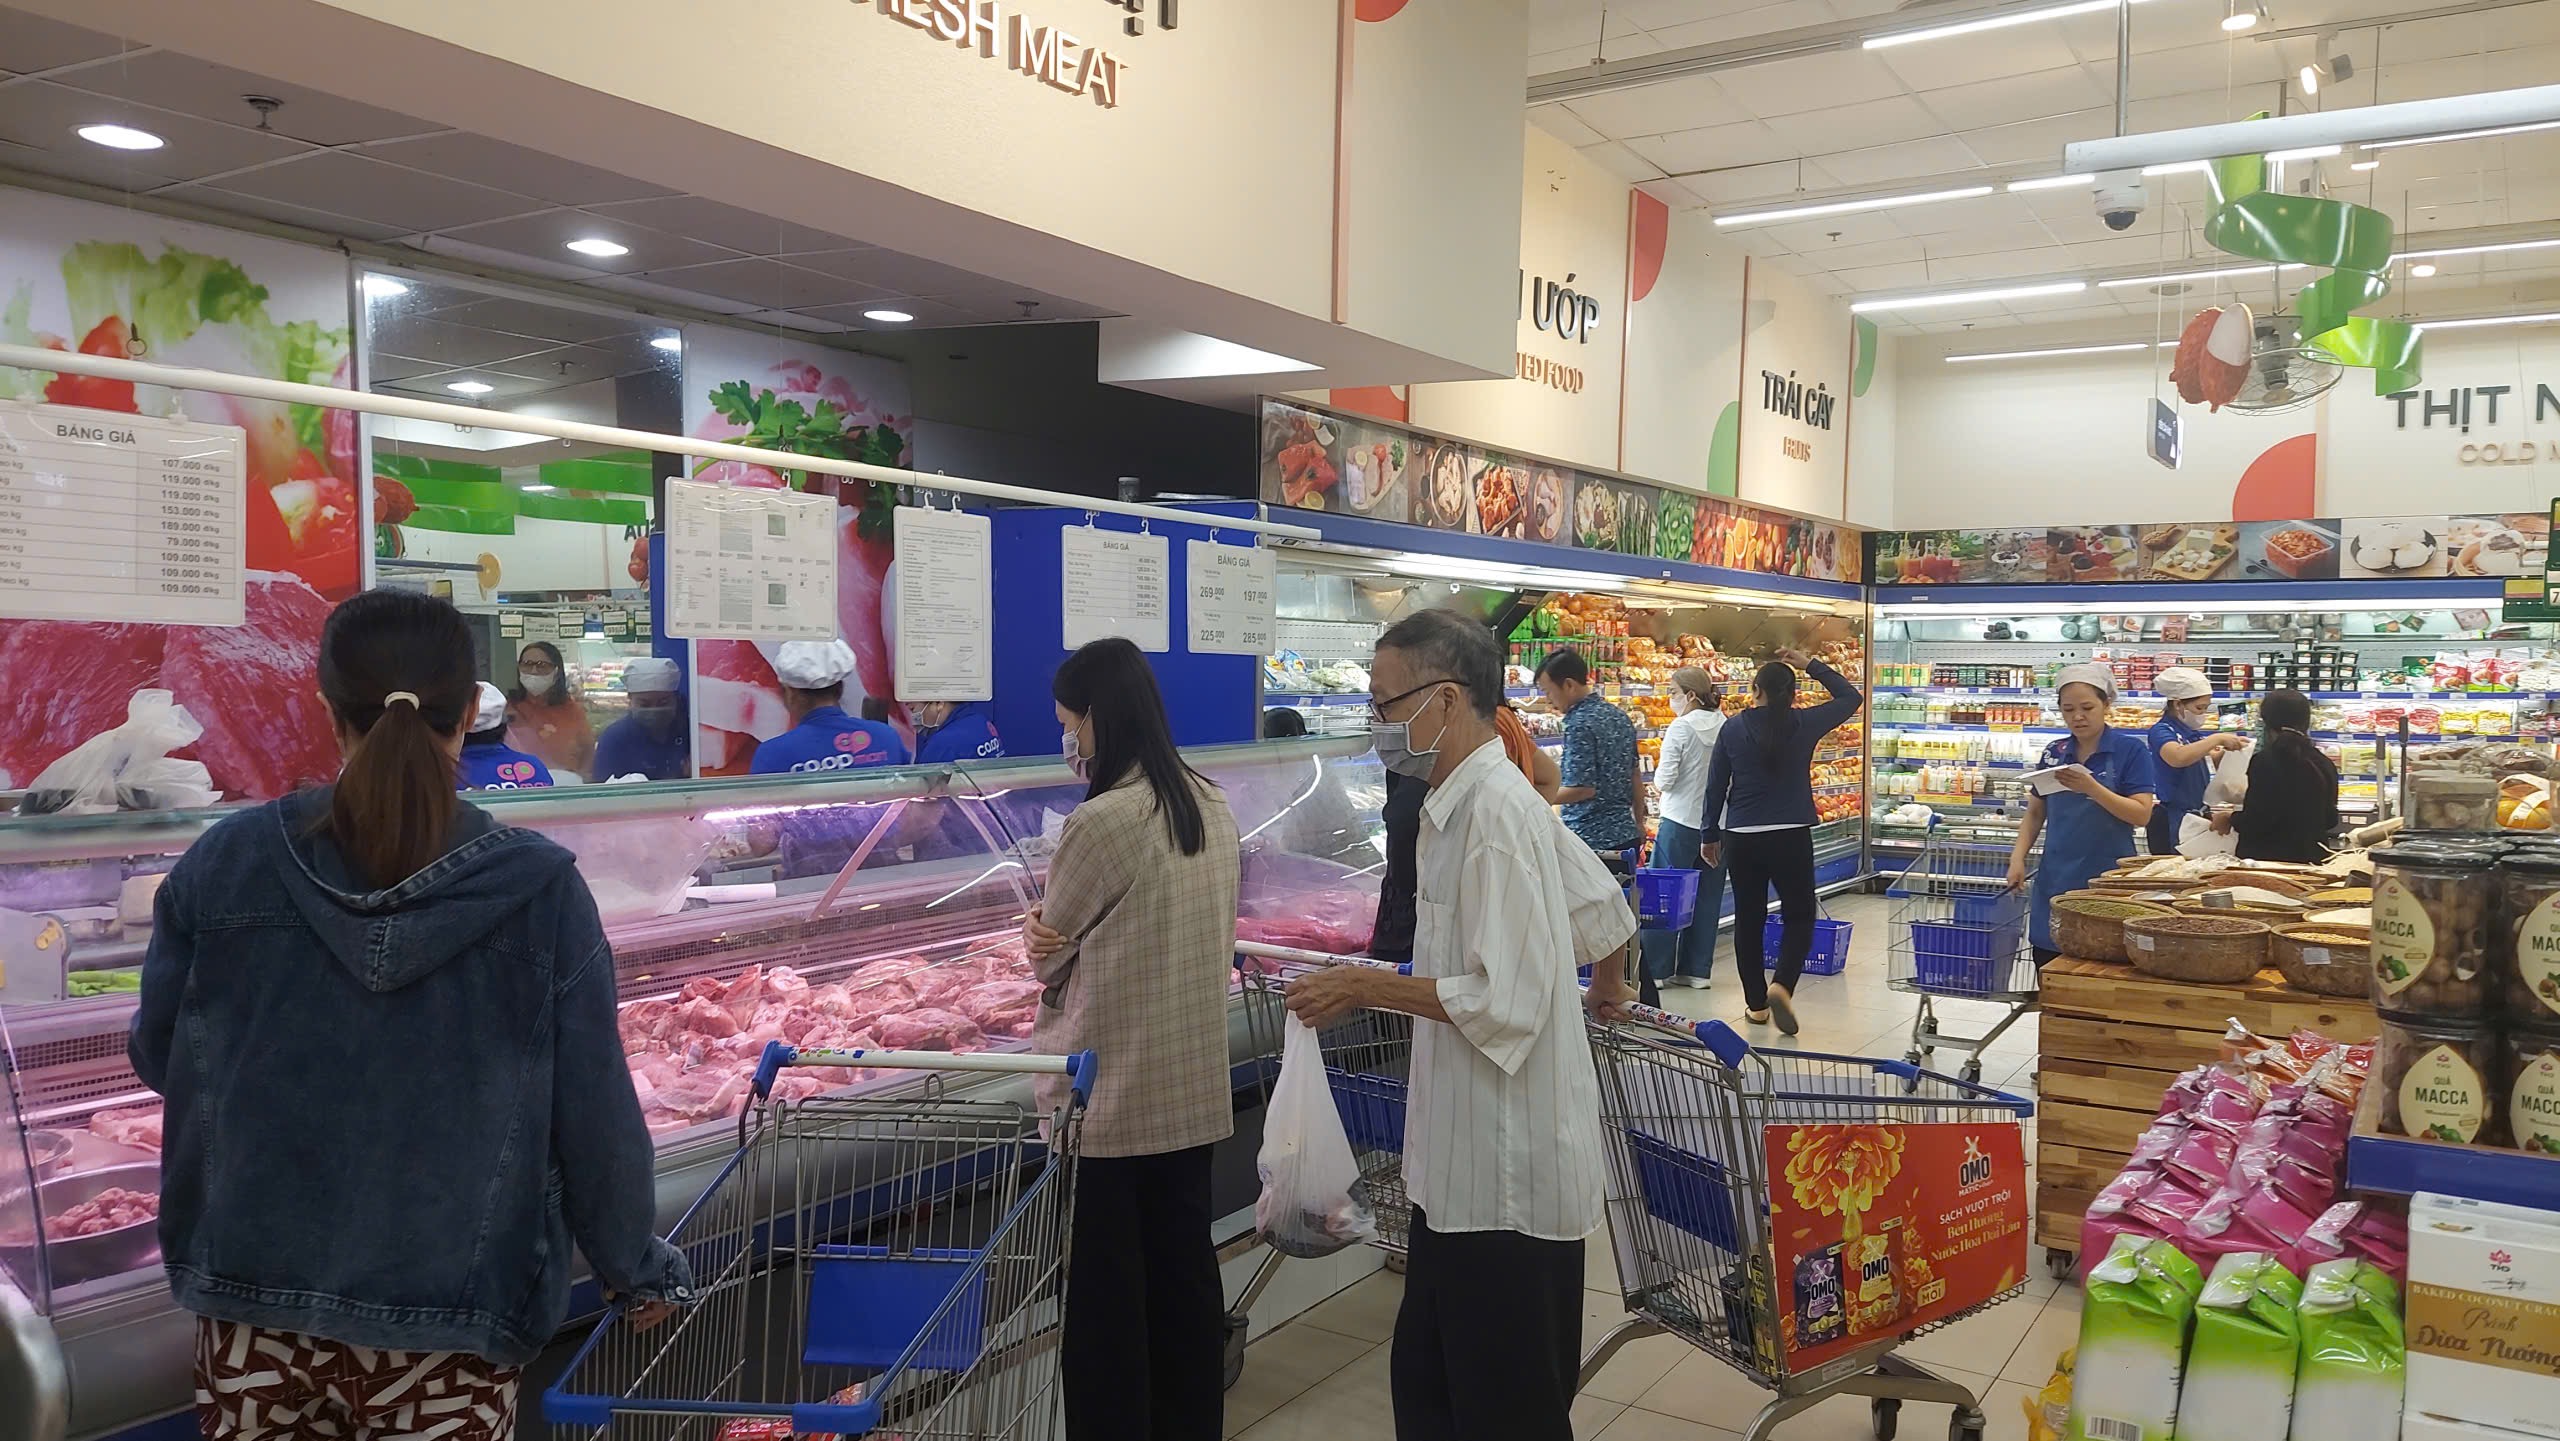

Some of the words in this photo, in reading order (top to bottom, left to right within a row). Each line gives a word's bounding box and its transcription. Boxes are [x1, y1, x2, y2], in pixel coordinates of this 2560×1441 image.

[1008, 14, 1128, 109] MEAT
[1533, 272, 1600, 344] ƯỚP
[1543, 359, 1584, 394] FOOD
[1762, 370, 1802, 420] TRÁI
[1805, 382, 1835, 431] CÂY
[2385, 385, 2511, 432] THỊT
[56, 424, 104, 441] BẢNG
[108, 430, 136, 445] GIÁ
[1782, 436, 1811, 462] FRUITS
[2459, 442, 2537, 465] COLD
[161, 459, 201, 470] 107.000
[161, 474, 201, 486] 119.000
[161, 490, 201, 501] 119.000
[161, 505, 201, 517] 153.000
[161, 521, 201, 532] 189.000
[166, 536, 200, 547] 79.000
[161, 552, 200, 563] 109.000
[1217, 554, 1237, 566] BẢNG
[1238, 556, 1251, 568] GIÁ
[161, 567, 200, 578] 109.000
[160, 583, 200, 594] 109.000
[2374, 919, 2416, 938] MACCA
[2415, 1087, 2469, 1105] MACCA
[1960, 1155, 1991, 1187] OMO
[1958, 1184, 1980, 1197] MATIC
[1940, 1208, 1963, 1225] SẠCH
[1965, 1198, 1989, 1214] VƯỢT
[1863, 1257, 1890, 1281] OMO
[1810, 1278, 1835, 1300] OMO
[2413, 1285, 2456, 1300] BAKED
[2459, 1292, 2521, 1311] COCONUT
